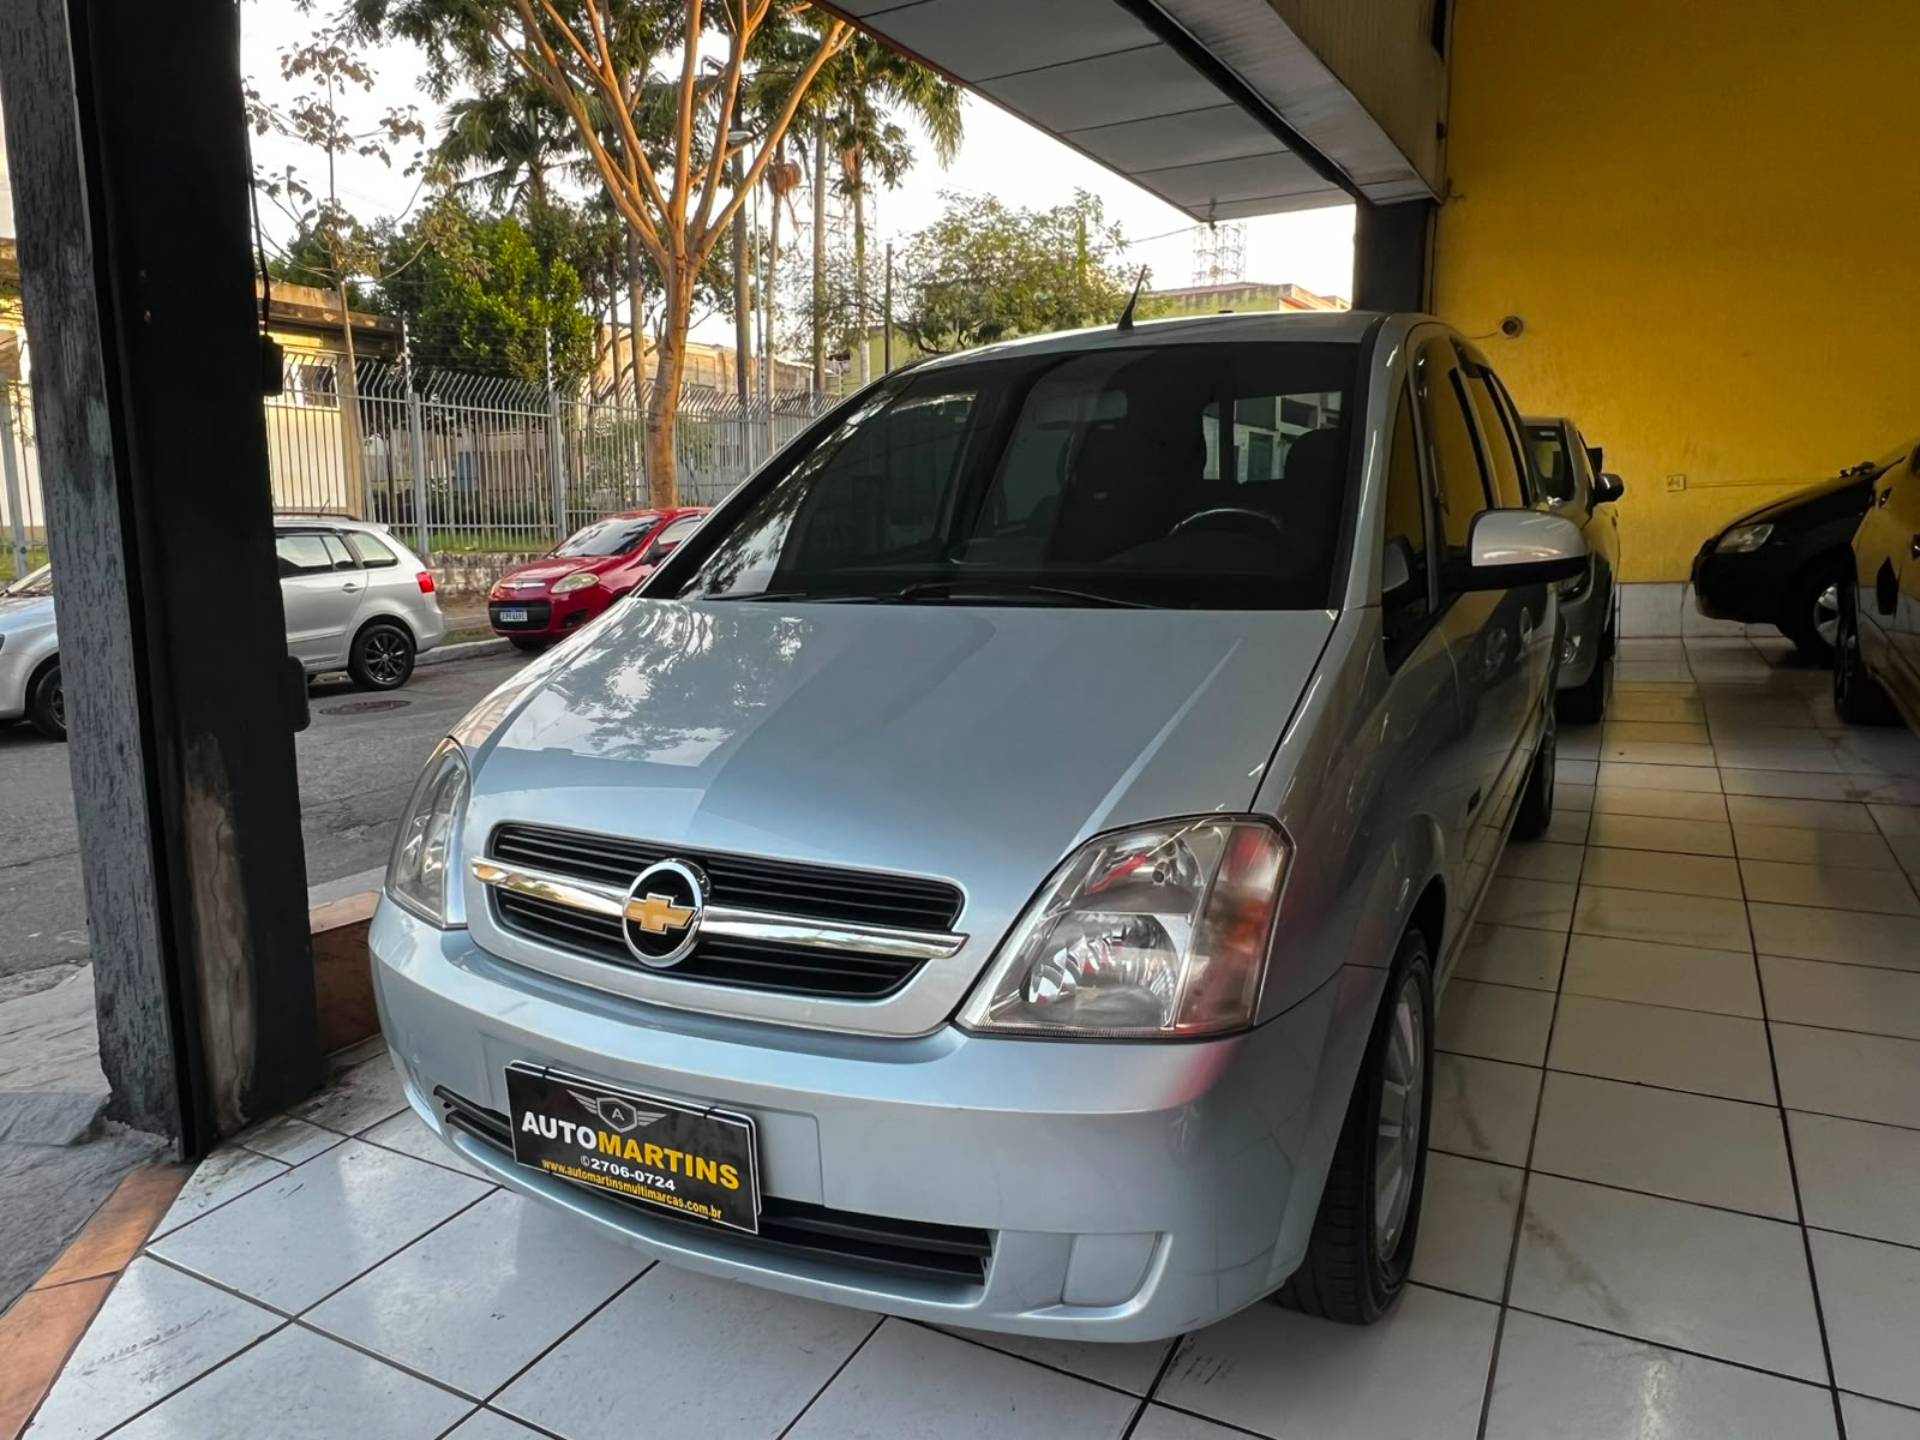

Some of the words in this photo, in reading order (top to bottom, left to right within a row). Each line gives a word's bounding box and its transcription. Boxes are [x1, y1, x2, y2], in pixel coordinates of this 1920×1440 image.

[611, 1108, 625, 1121] A
[521, 1110, 740, 1191] AUTOMARTINS
[590, 1157, 676, 1191] 2706-0724
[541, 1159, 723, 1219] www.automartinsmultimarcas.com.br
